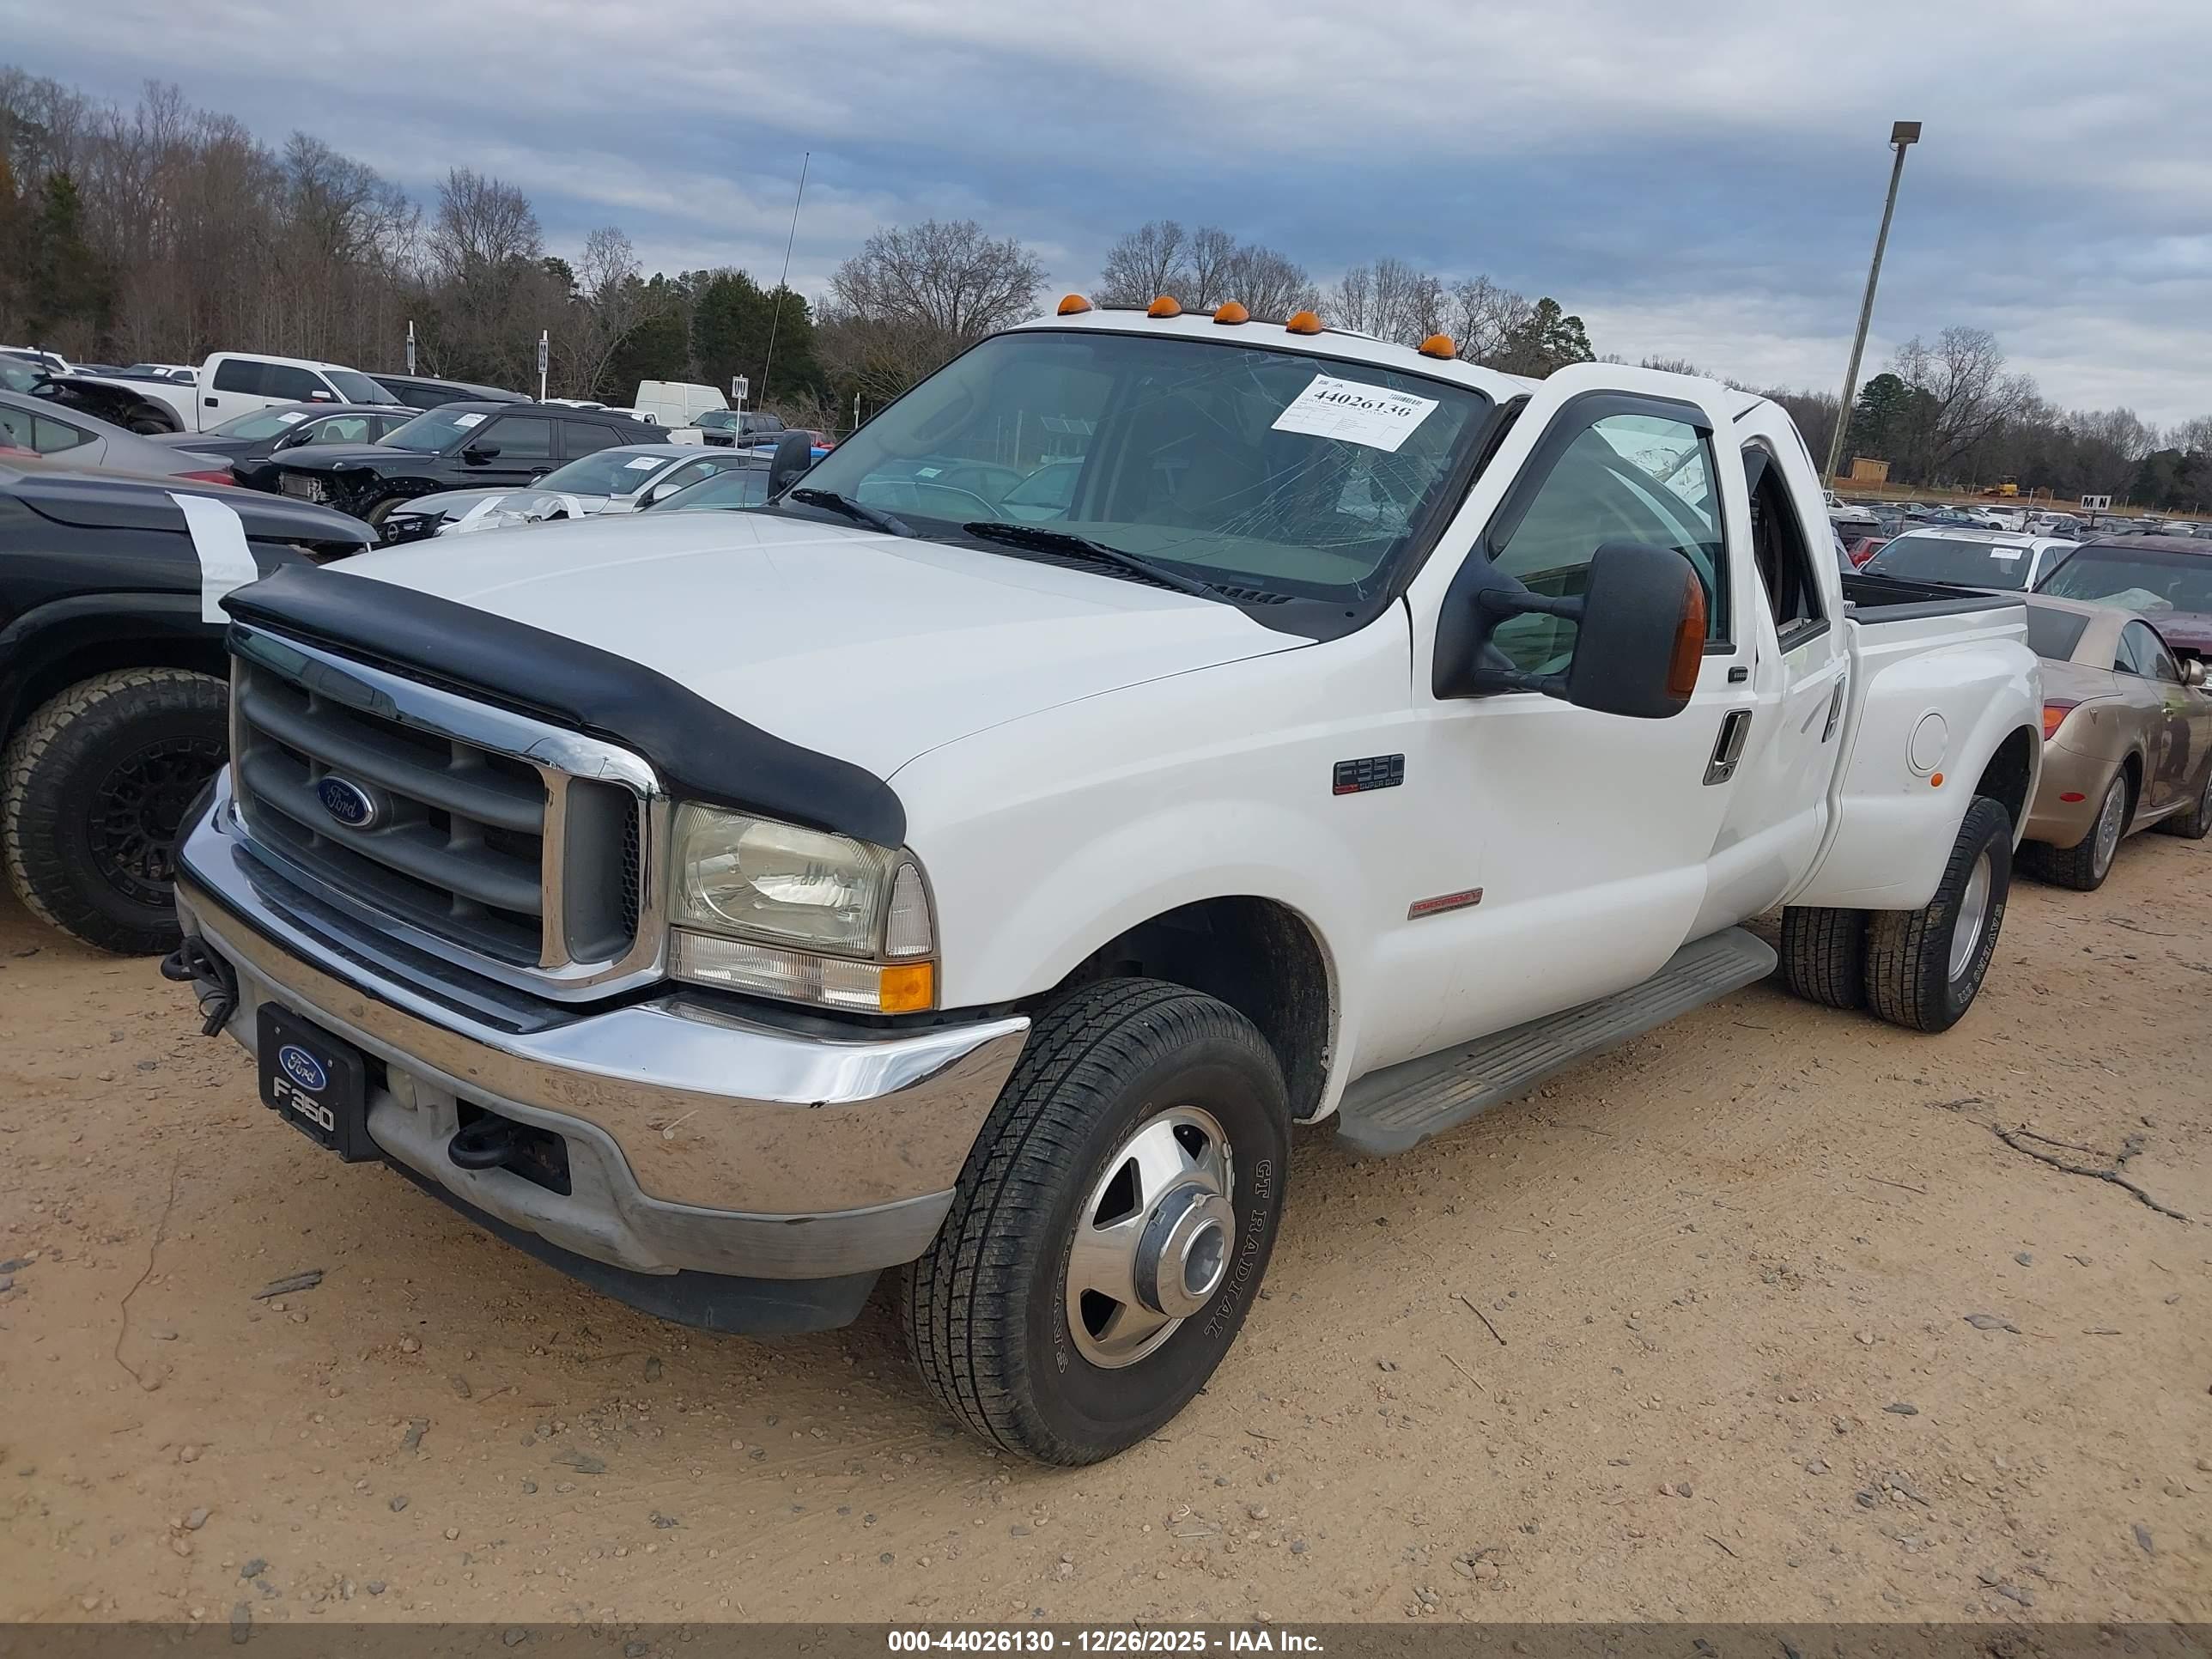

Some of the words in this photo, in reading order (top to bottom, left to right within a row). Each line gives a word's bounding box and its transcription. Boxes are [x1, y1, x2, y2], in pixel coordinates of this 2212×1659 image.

[540, 343, 546, 368] SS
[2082, 497, 2094, 507] M
[2099, 498, 2107, 507] N
[1385, 778, 1403, 787] DUTY
[326, 785, 358, 818] Ford
[1972, 903, 2003, 982] SAVERO
[288, 1051, 316, 1084] Ford
[274, 1077, 335, 1132] F350
[1255, 1160, 1272, 1199] GT
[1203, 1209, 1267, 1340] RADIAL
